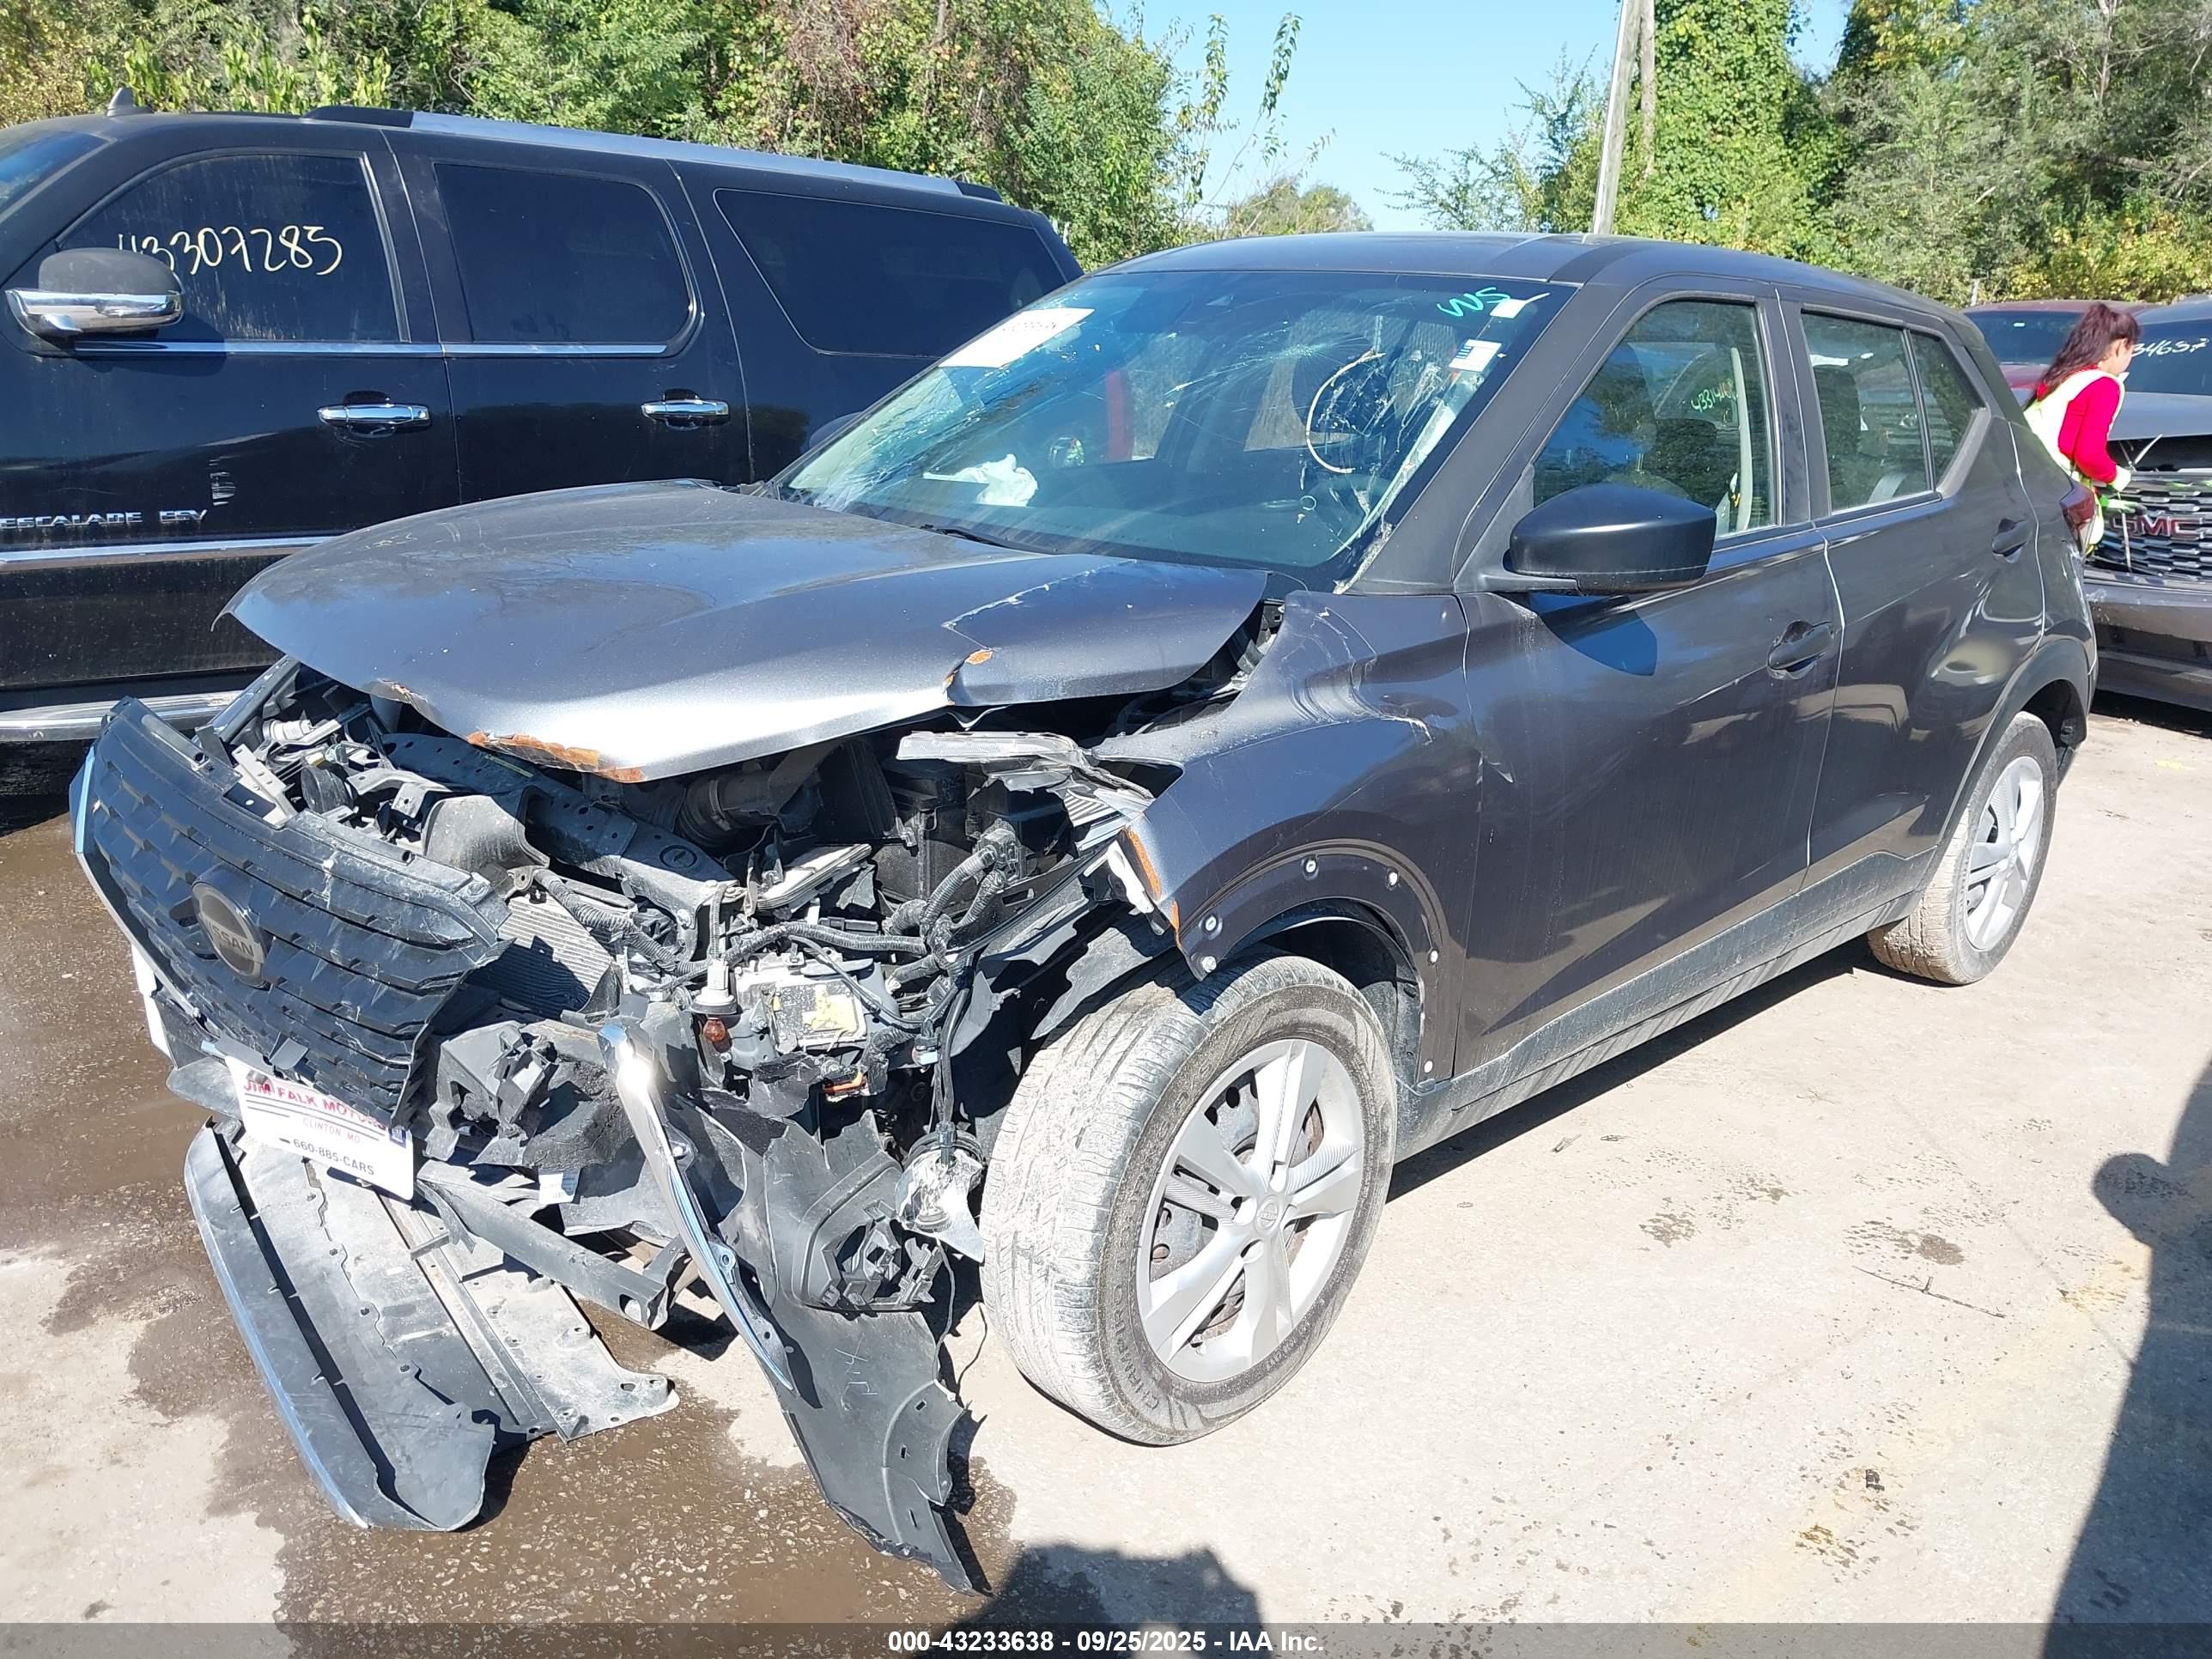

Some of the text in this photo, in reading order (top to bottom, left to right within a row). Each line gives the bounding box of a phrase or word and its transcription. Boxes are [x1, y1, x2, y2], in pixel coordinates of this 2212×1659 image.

[0, 508, 208, 530] ESCALADE ESV
[2110, 514, 2205, 538] GMC
[243, 1079, 271, 1096] JIM
[278, 1088, 317, 1107] FALK
[303, 1117, 342, 1136] CLINTON
